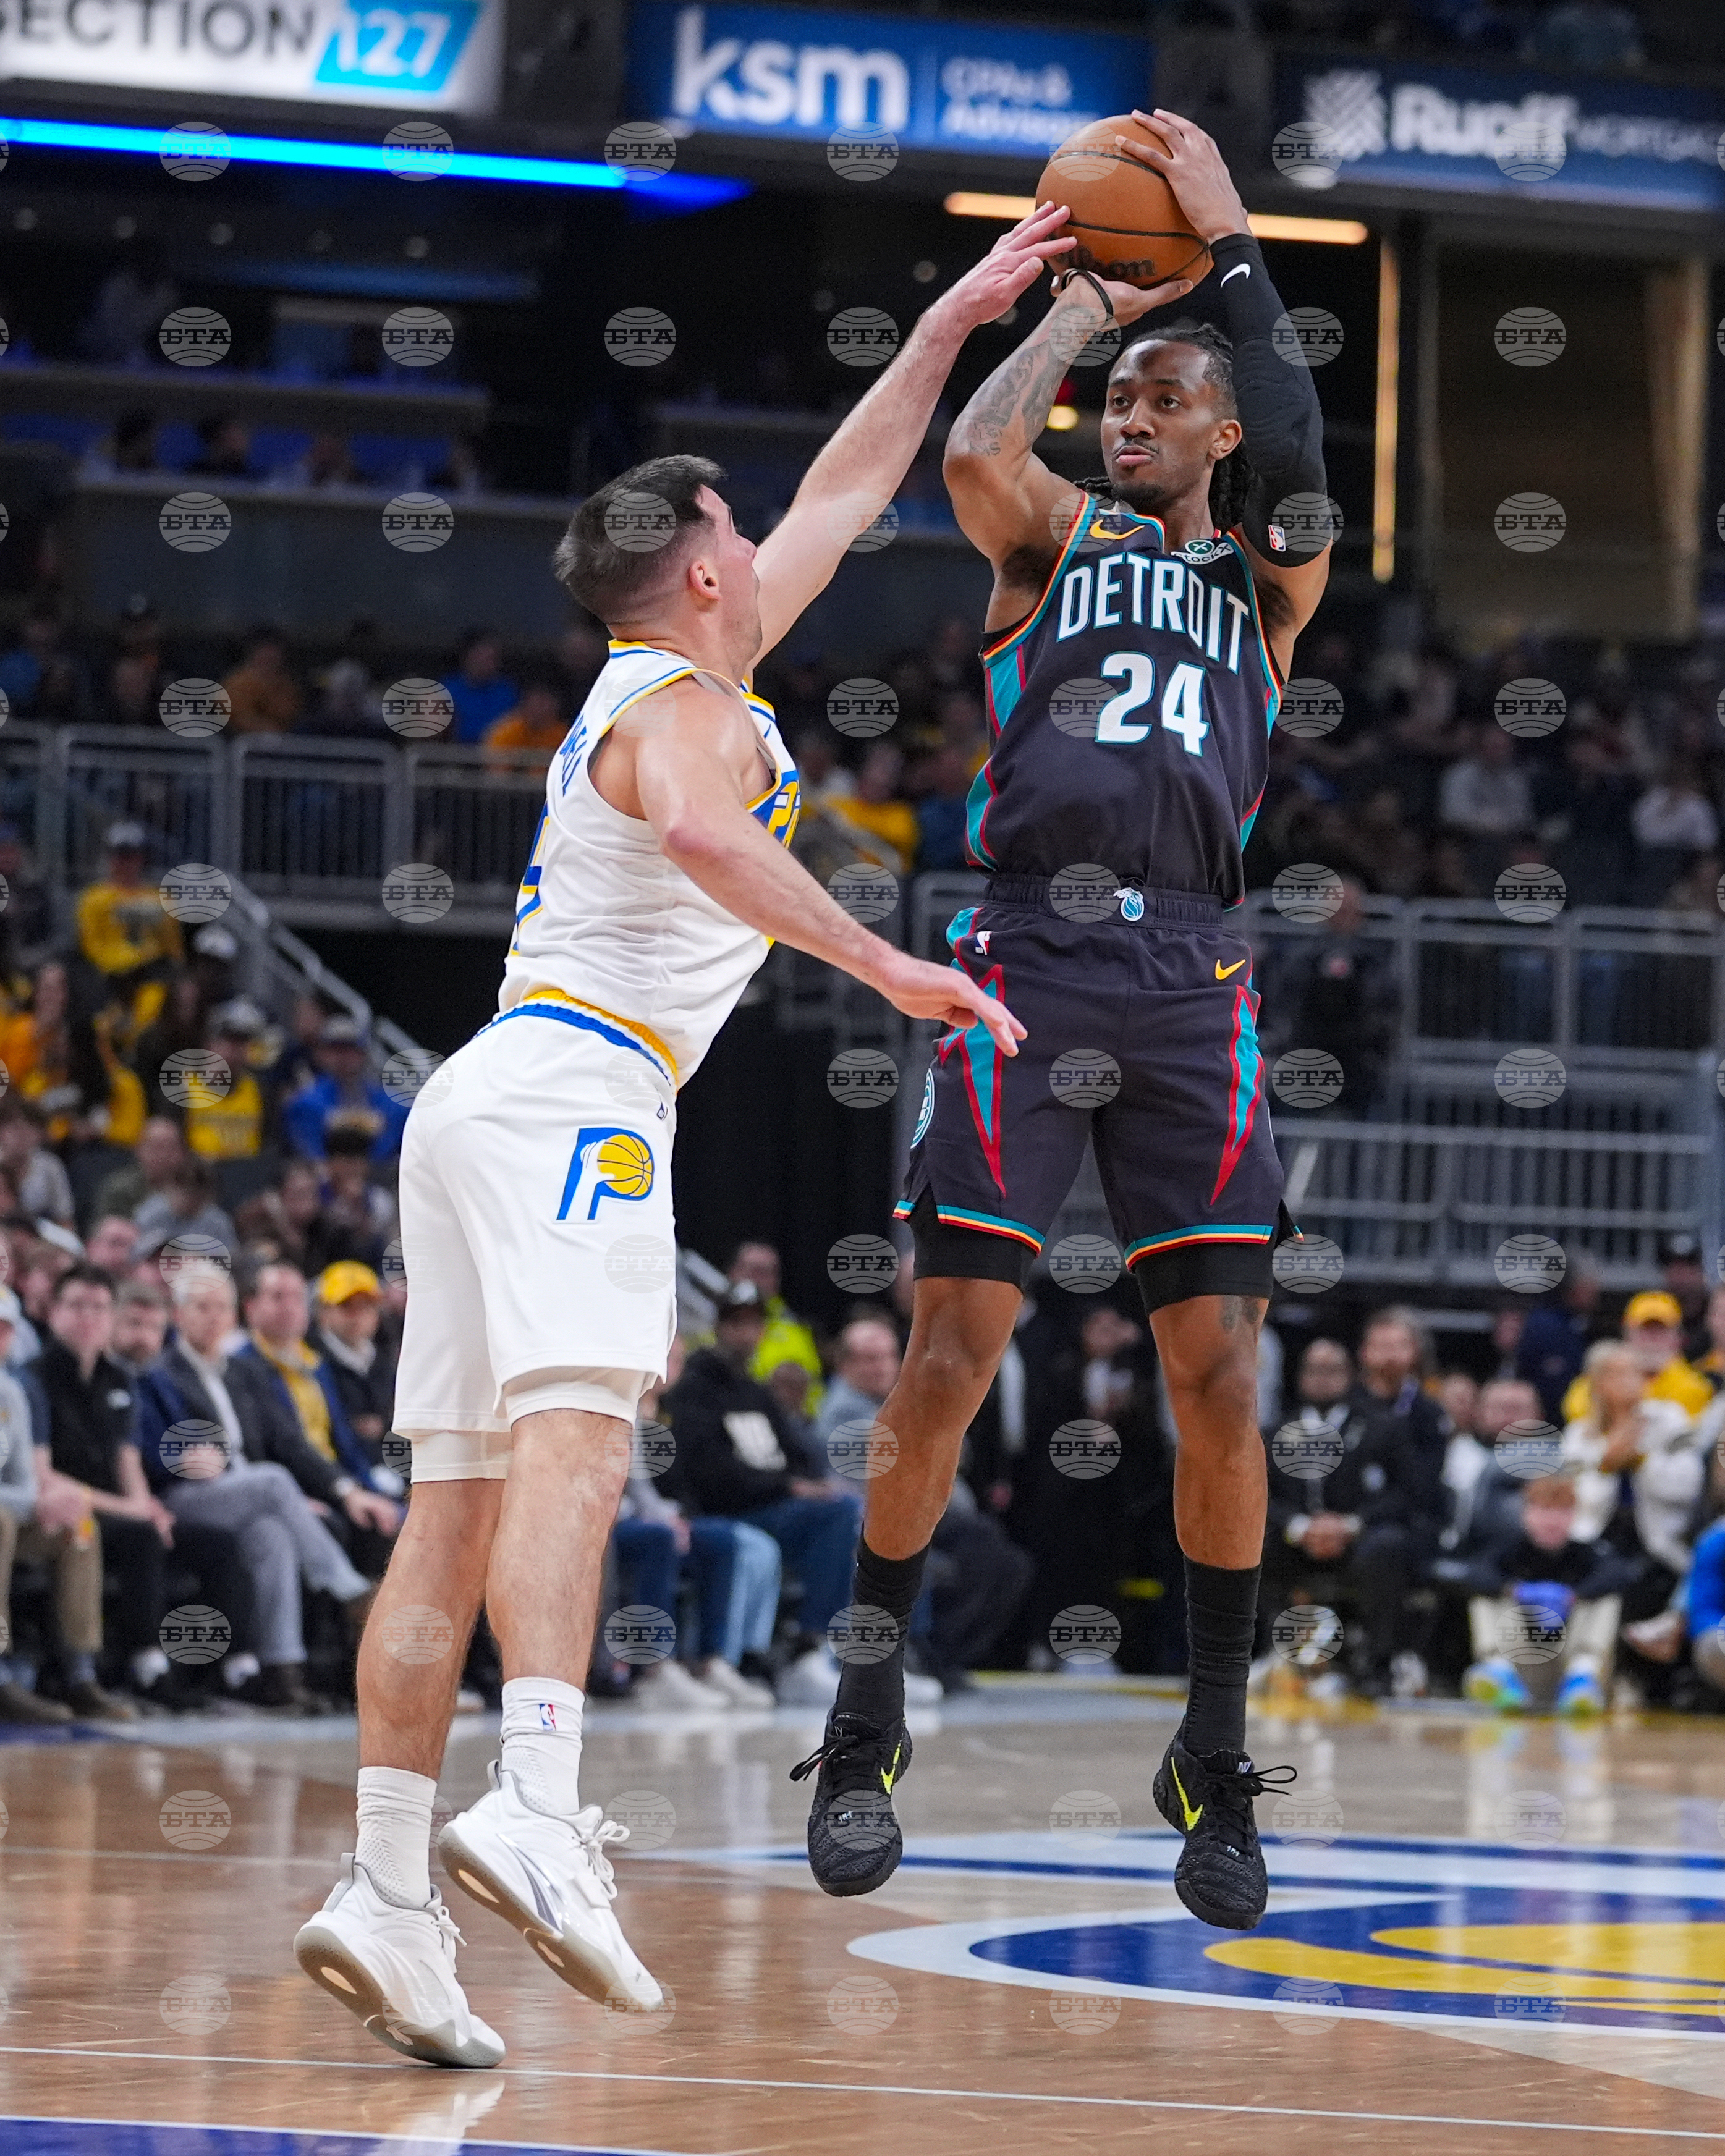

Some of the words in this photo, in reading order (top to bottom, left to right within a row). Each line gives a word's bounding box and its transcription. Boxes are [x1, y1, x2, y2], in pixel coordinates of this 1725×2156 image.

[0, 0, 315, 58] ECTION
[331, 9, 452, 79] 127
[672, 5, 910, 132] ksm
[1056, 551, 1250, 675] DETROIT
[1095, 651, 1210, 757] 24
